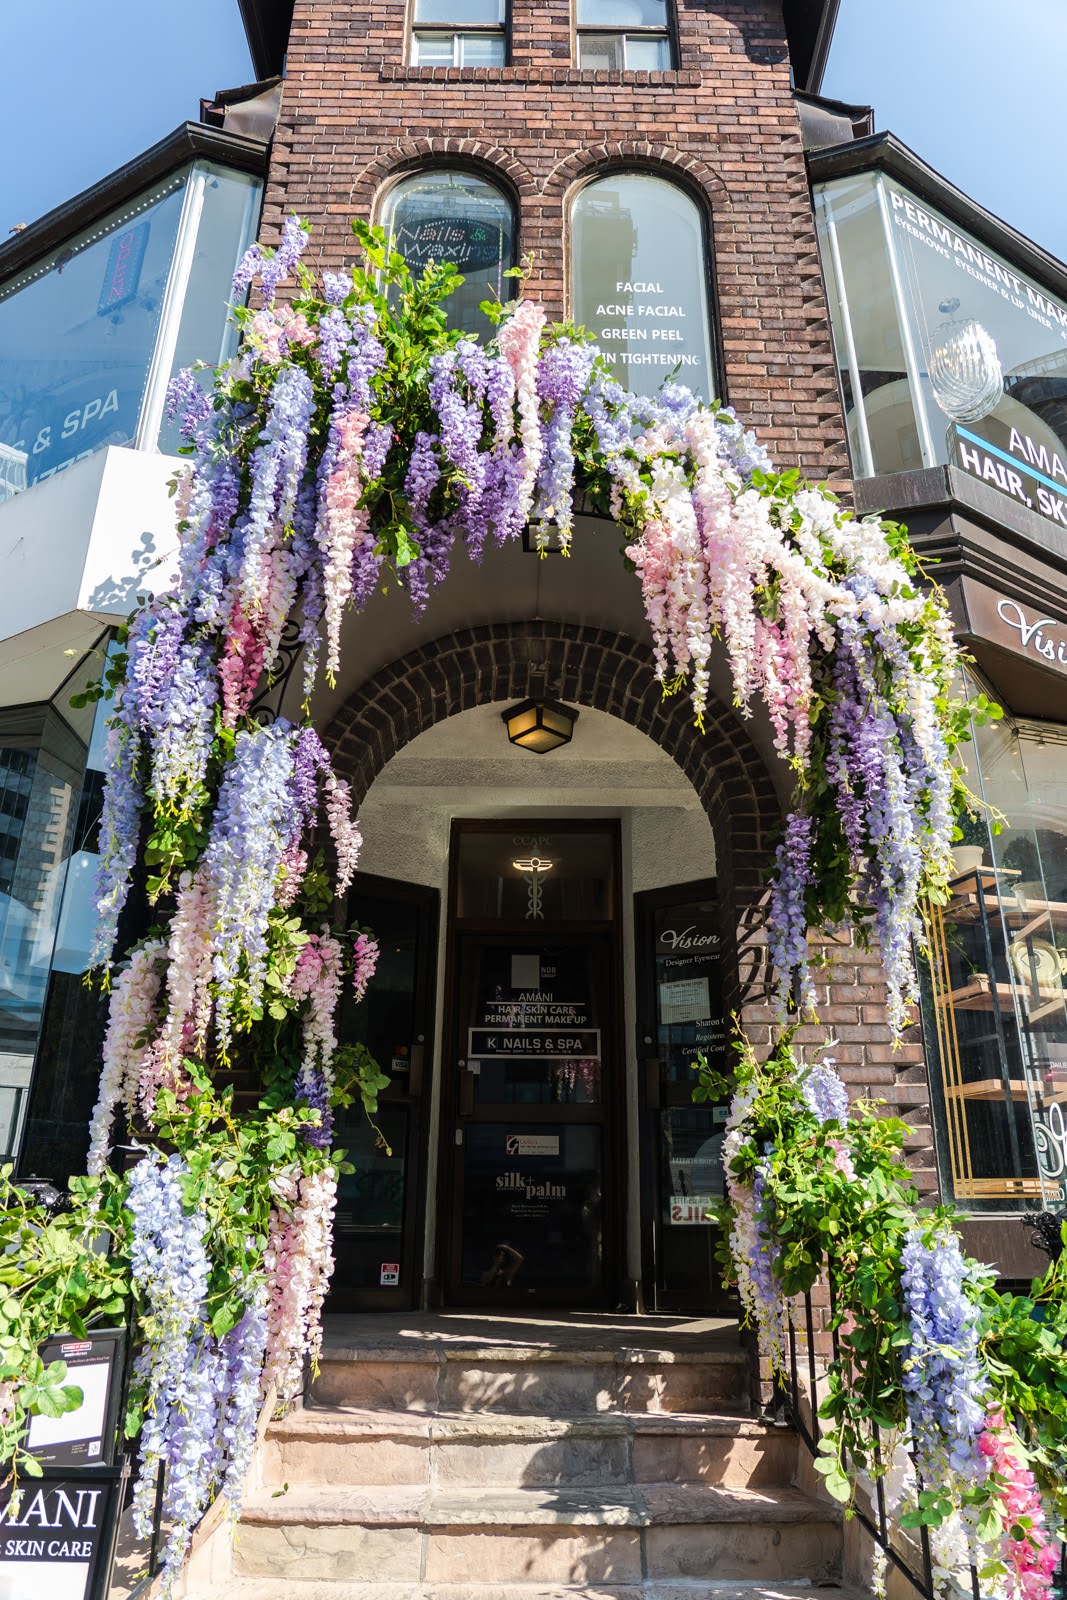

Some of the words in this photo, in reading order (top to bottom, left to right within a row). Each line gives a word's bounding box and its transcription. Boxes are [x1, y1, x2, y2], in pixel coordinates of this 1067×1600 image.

[397, 226, 465, 241] Nails
[470, 228, 489, 241] &
[890, 191, 1020, 295] PERMANENT
[894, 214, 950, 259] EYEBROWS
[955, 256, 1000, 293] EYELINER
[1010, 296, 1025, 309] LIP
[1026, 306, 1053, 330] LINER
[616, 282, 663, 293] FACIAL
[596, 305, 634, 315] ACNE
[638, 306, 686, 316] FACIAL
[601, 328, 647, 339] GREEN
[652, 330, 683, 340] PEEL
[33, 426, 51, 454] &
[61, 389, 119, 438] SPA
[959, 442, 1032, 508] HAIR,
[1036, 488, 1067, 525] SK
[660, 925, 720, 949] Vision
[665, 957, 693, 967] Designer
[694, 954, 720, 964] Eyewear
[518, 992, 553, 1001] AMANI
[526, 1006, 548, 1014] SKIN
[485, 1015, 543, 1023] PERMANENT
[545, 1015, 573, 1023] MAKE
[574, 1016, 587, 1024] UP
[696, 1019, 719, 1027] Sharon
[503, 1038, 541, 1049] NAILS
[545, 1039, 554, 1049] &
[557, 1039, 583, 1049] SPA
[696, 1034, 726, 1042] Registere
[526, 1181, 567, 1200] palm
[5, 1540, 46, 1556] SKIN
[48, 1540, 93, 1557] CARE
